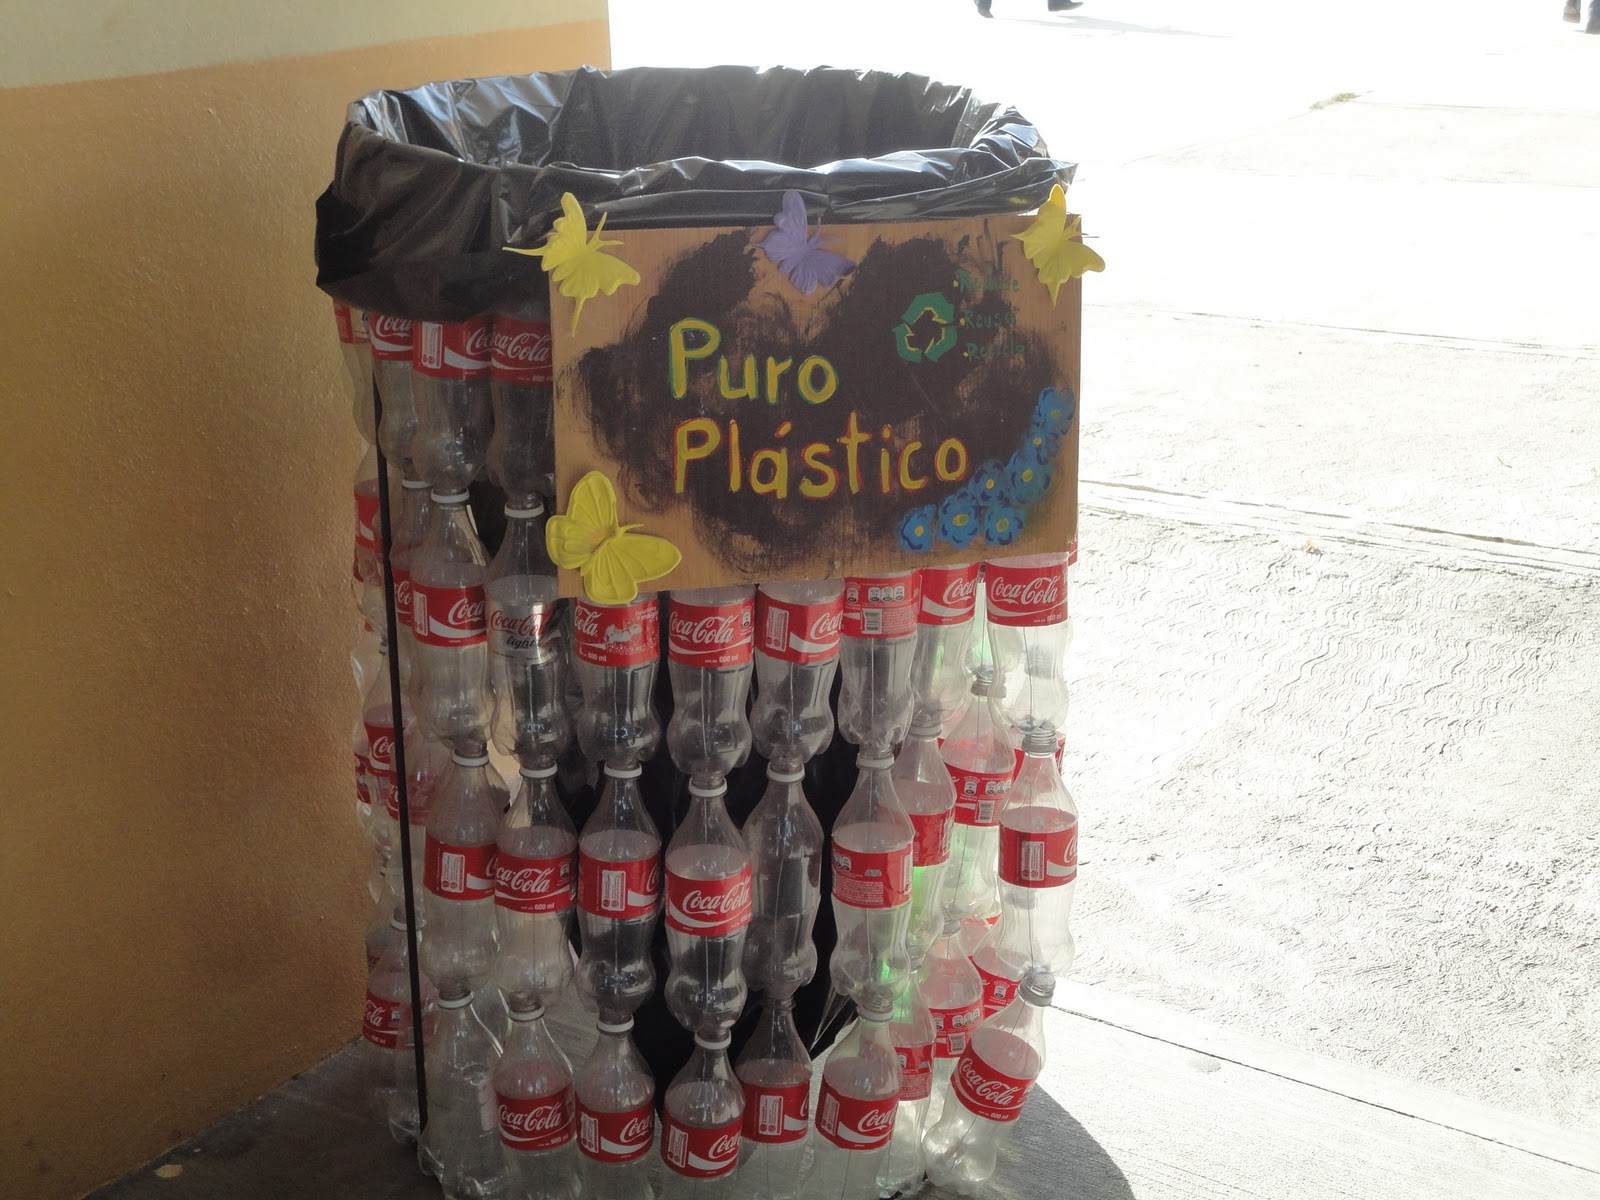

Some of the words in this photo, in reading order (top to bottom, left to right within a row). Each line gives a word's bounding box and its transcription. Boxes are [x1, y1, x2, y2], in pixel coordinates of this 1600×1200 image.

[669, 317, 839, 405] Puro
[673, 410, 970, 499] Plástico
[991, 575, 1061, 605] Coca-Cola
[506, 637, 536, 649] light
[669, 612, 739, 644] Coca-Cola
[682, 877, 751, 915] Coca-Cola
[958, 1057, 1021, 1106] Coca-Cola
[499, 1101, 563, 1132] Coca-Cola
